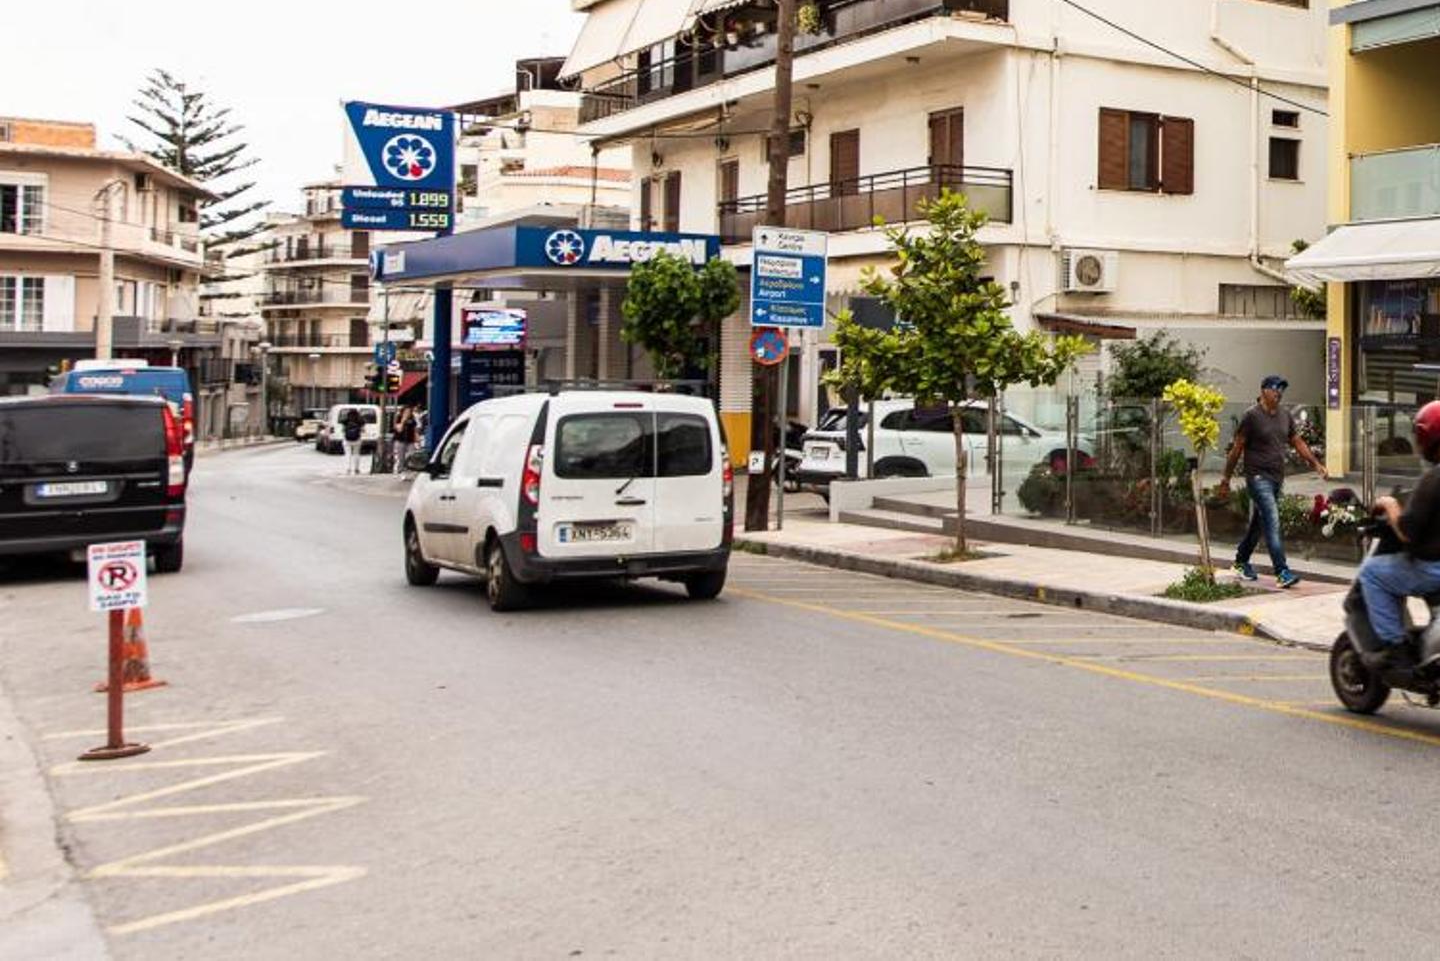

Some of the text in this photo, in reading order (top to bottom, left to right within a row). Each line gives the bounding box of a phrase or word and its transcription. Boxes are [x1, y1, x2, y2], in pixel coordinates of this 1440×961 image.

[362, 109, 442, 131] AEGEAN
[410, 192, 448, 207] 1.899
[351, 213, 448, 227] Diesel 1.559
[758, 290, 786, 299] Airport
